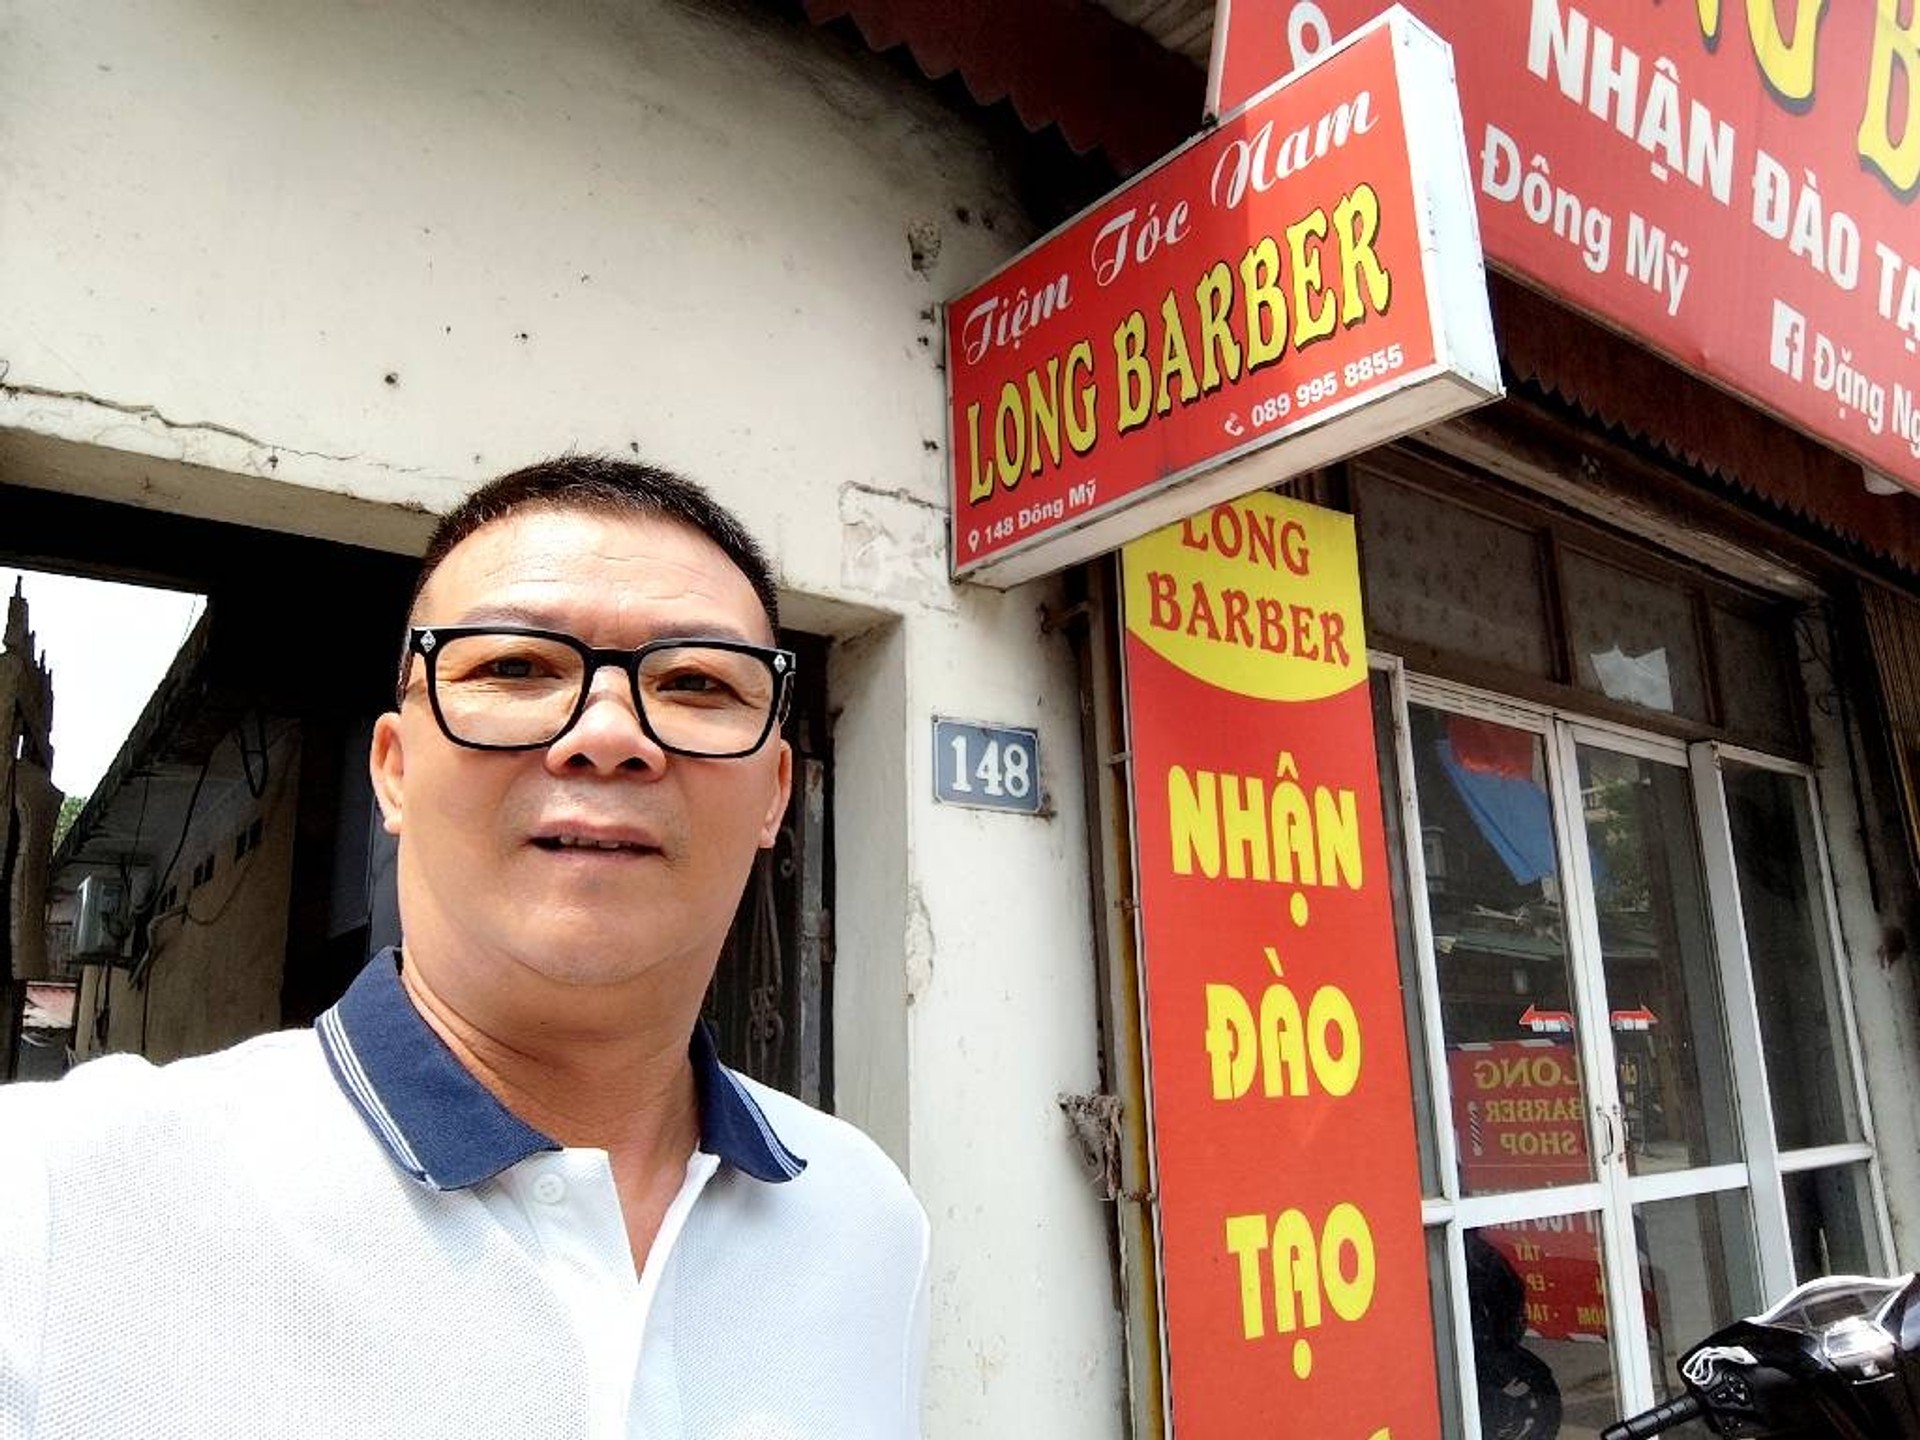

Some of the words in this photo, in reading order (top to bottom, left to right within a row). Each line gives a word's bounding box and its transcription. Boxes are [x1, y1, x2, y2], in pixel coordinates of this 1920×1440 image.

[961, 273, 1075, 366] Tiệm
[1090, 200, 1193, 287] Tóc
[1210, 90, 1380, 211] Nam
[1480, 123, 1613, 274] Đông
[1625, 211, 1690, 317] Mỹ
[1527, 0, 1735, 206] NHẬN
[1752, 149, 1862, 291] ĐÀO
[967, 339, 1100, 507] LONG
[1113, 183, 1392, 434] BARBER
[1251, 393, 1291, 427] 089
[1295, 371, 1338, 408] 995
[1344, 344, 1404, 387] 8855
[1813, 332, 1886, 435] Đặng
[984, 516, 1014, 544] 148
[1018, 498, 1064, 530] Đông
[1068, 479, 1097, 508] Mỹ
[1147, 571, 1351, 669] BARBER
[951, 735, 1031, 798] 148
[1167, 751, 1364, 927] NHẬN
[1205, 946, 1361, 1100] ĐÀO
[1225, 1202, 1376, 1380] TẠO
